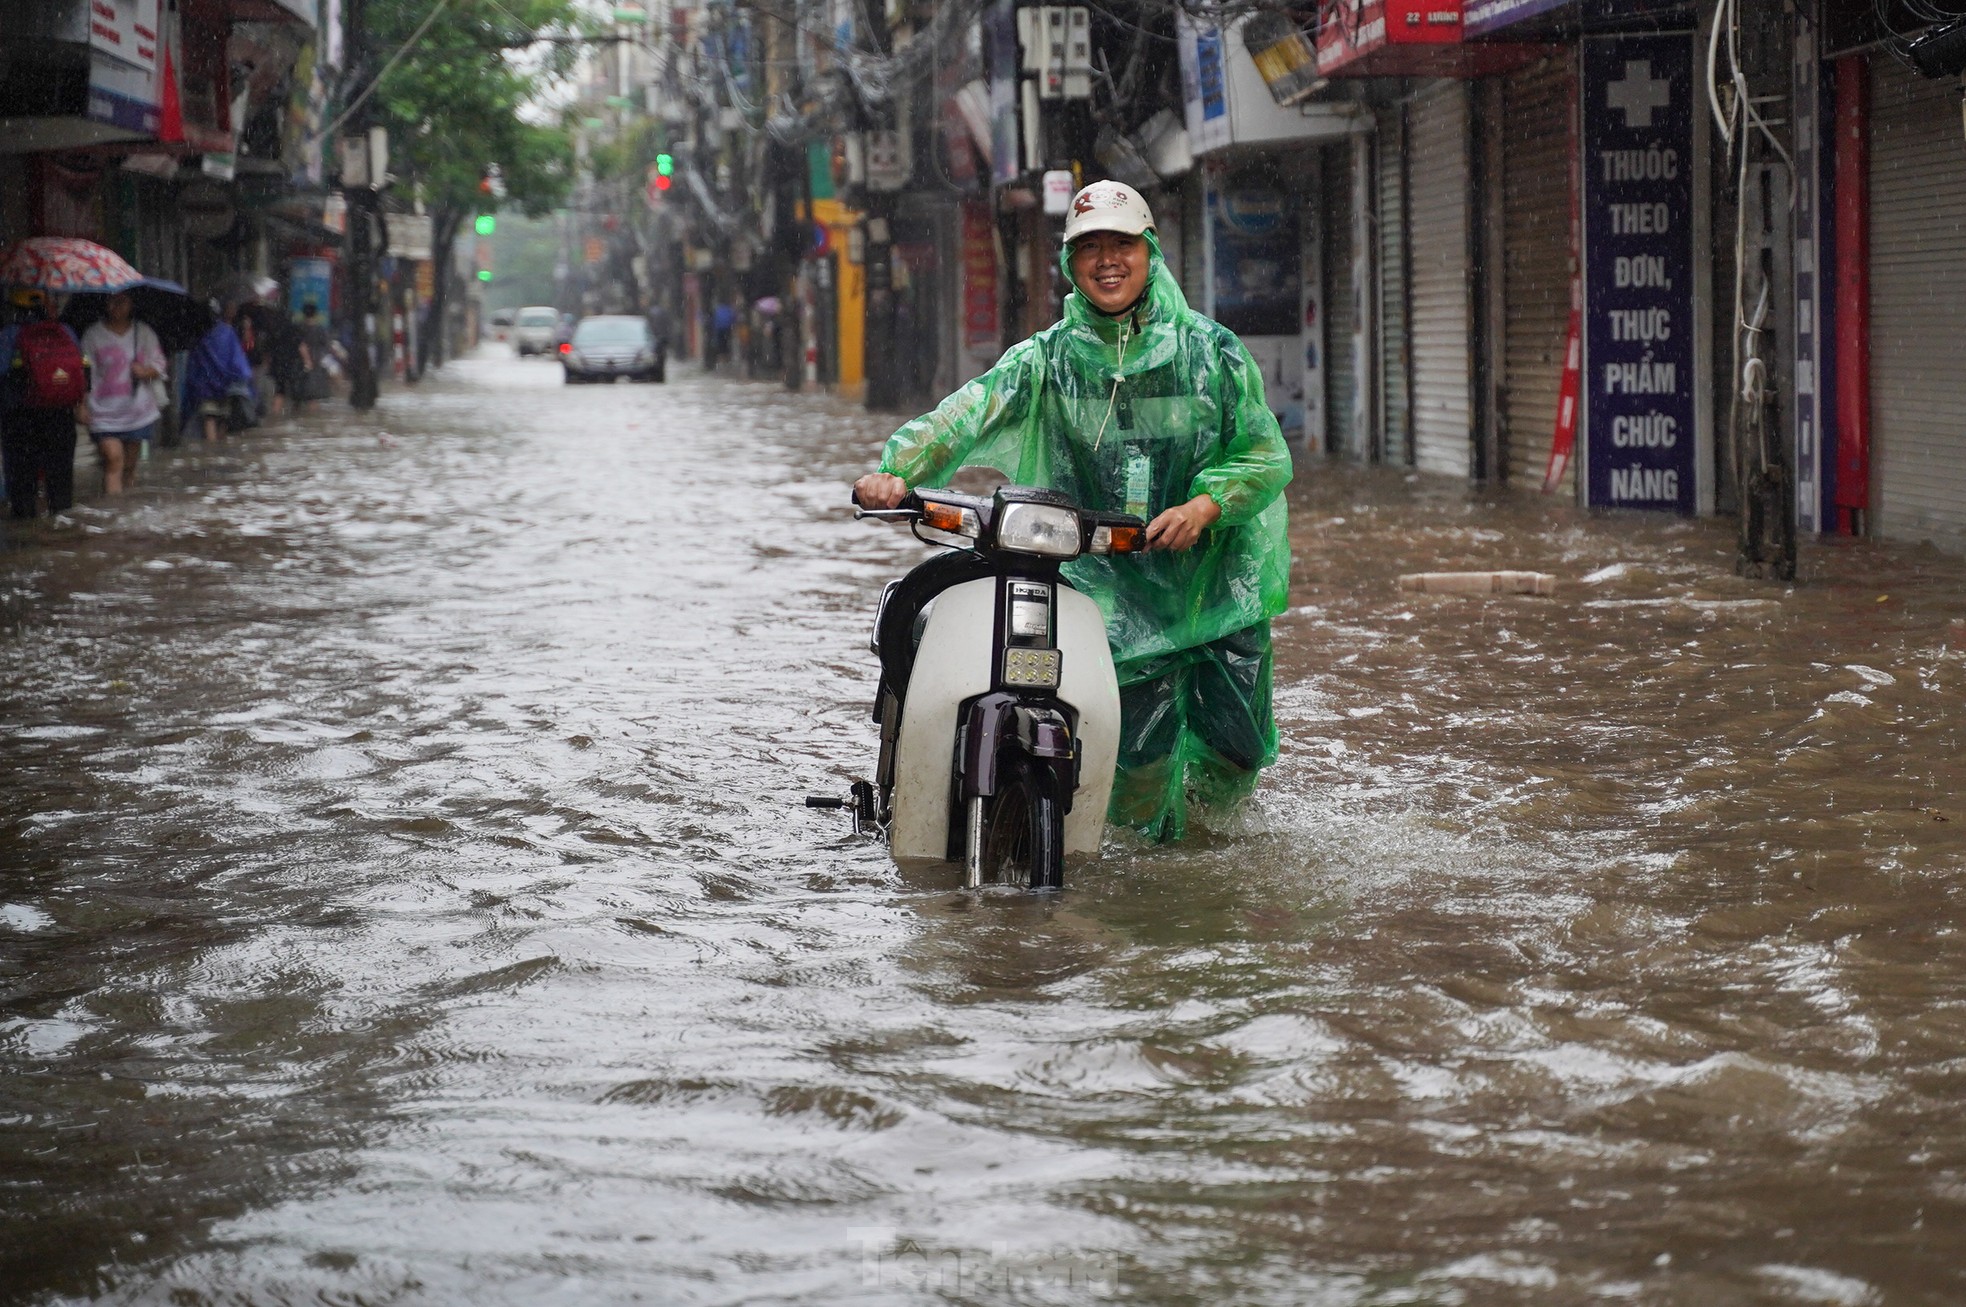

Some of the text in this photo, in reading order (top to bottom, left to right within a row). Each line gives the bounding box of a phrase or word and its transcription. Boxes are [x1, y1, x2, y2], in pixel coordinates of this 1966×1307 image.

[1601, 138, 1678, 181] THUỐC
[1609, 202, 1670, 235] THEO
[1615, 253, 1672, 291] ĐƠN,
[1608, 306, 1671, 347] THỰC
[1606, 350, 1676, 394] PHẨM
[1613, 409, 1677, 448] CHỨC
[1611, 462, 1679, 501] NĂNG
